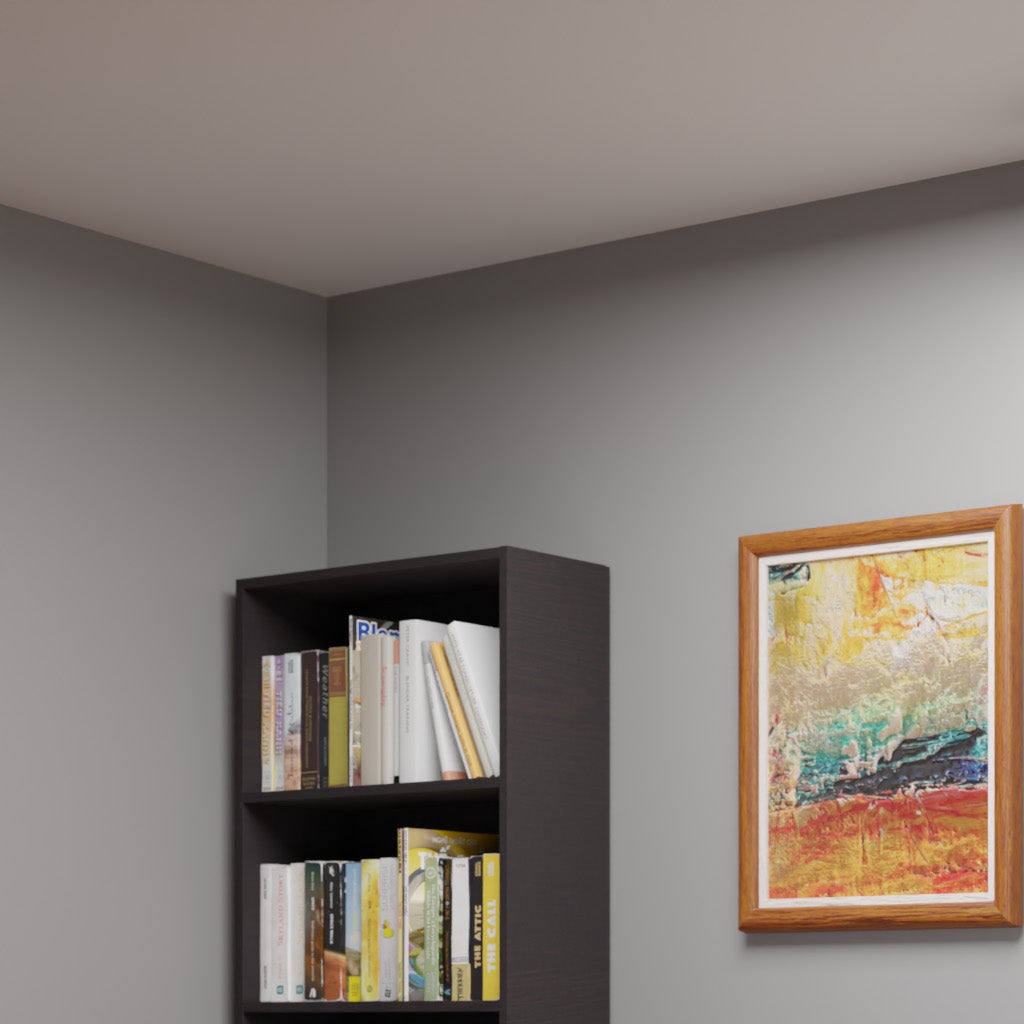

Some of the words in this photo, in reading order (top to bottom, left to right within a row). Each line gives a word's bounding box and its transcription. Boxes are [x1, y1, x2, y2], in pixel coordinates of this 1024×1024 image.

[321, 664, 330, 719] Weather
[474, 905, 482, 942] ATTIC
[487, 900, 497, 939] CALL
[474, 944, 482, 969] THE
[487, 944, 497, 973] THE
